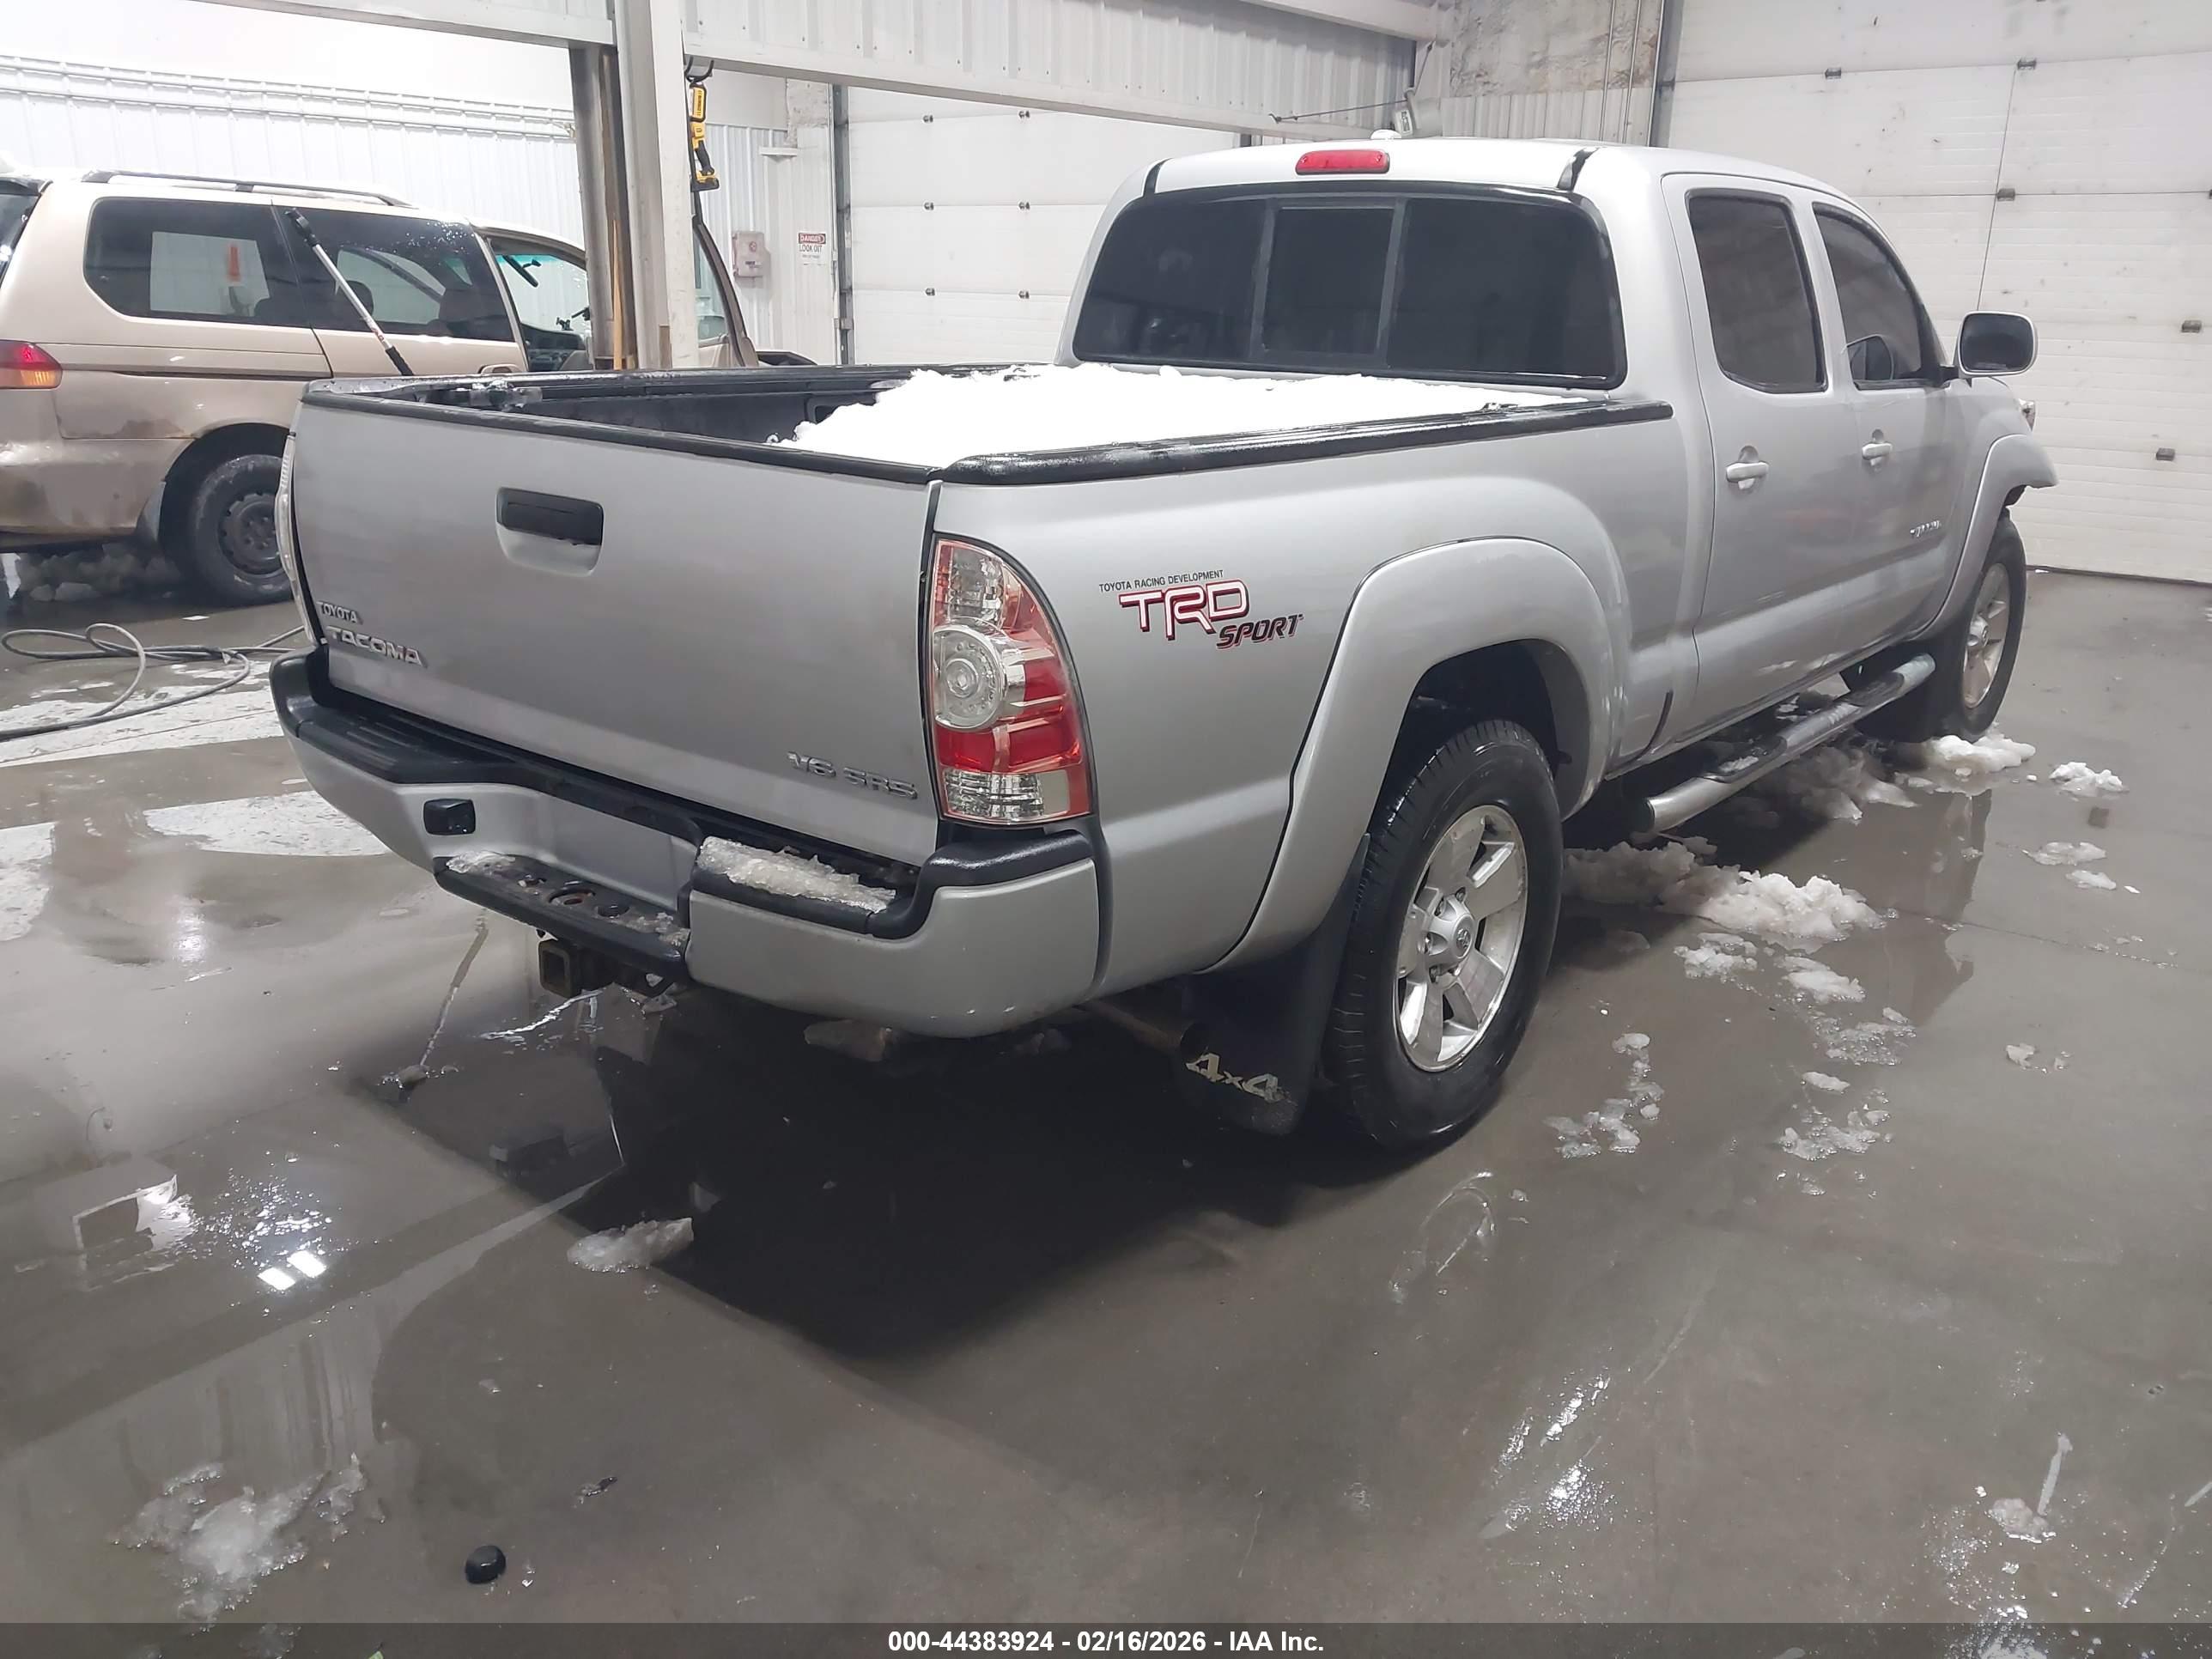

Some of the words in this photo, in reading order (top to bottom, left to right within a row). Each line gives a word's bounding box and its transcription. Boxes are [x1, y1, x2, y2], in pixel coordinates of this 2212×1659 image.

[799, 234, 822, 242] DANGER
[1099, 580, 1132, 593] TOYOTA
[1134, 576, 1165, 588] RACING
[1168, 569, 1224, 585] DEVELOPMENT
[315, 600, 361, 624] TOYOTA
[1118, 579, 1250, 641] TRD
[1216, 614, 1304, 649] SPORT
[325, 625, 426, 668] TACOMA
[787, 750, 836, 778] V6
